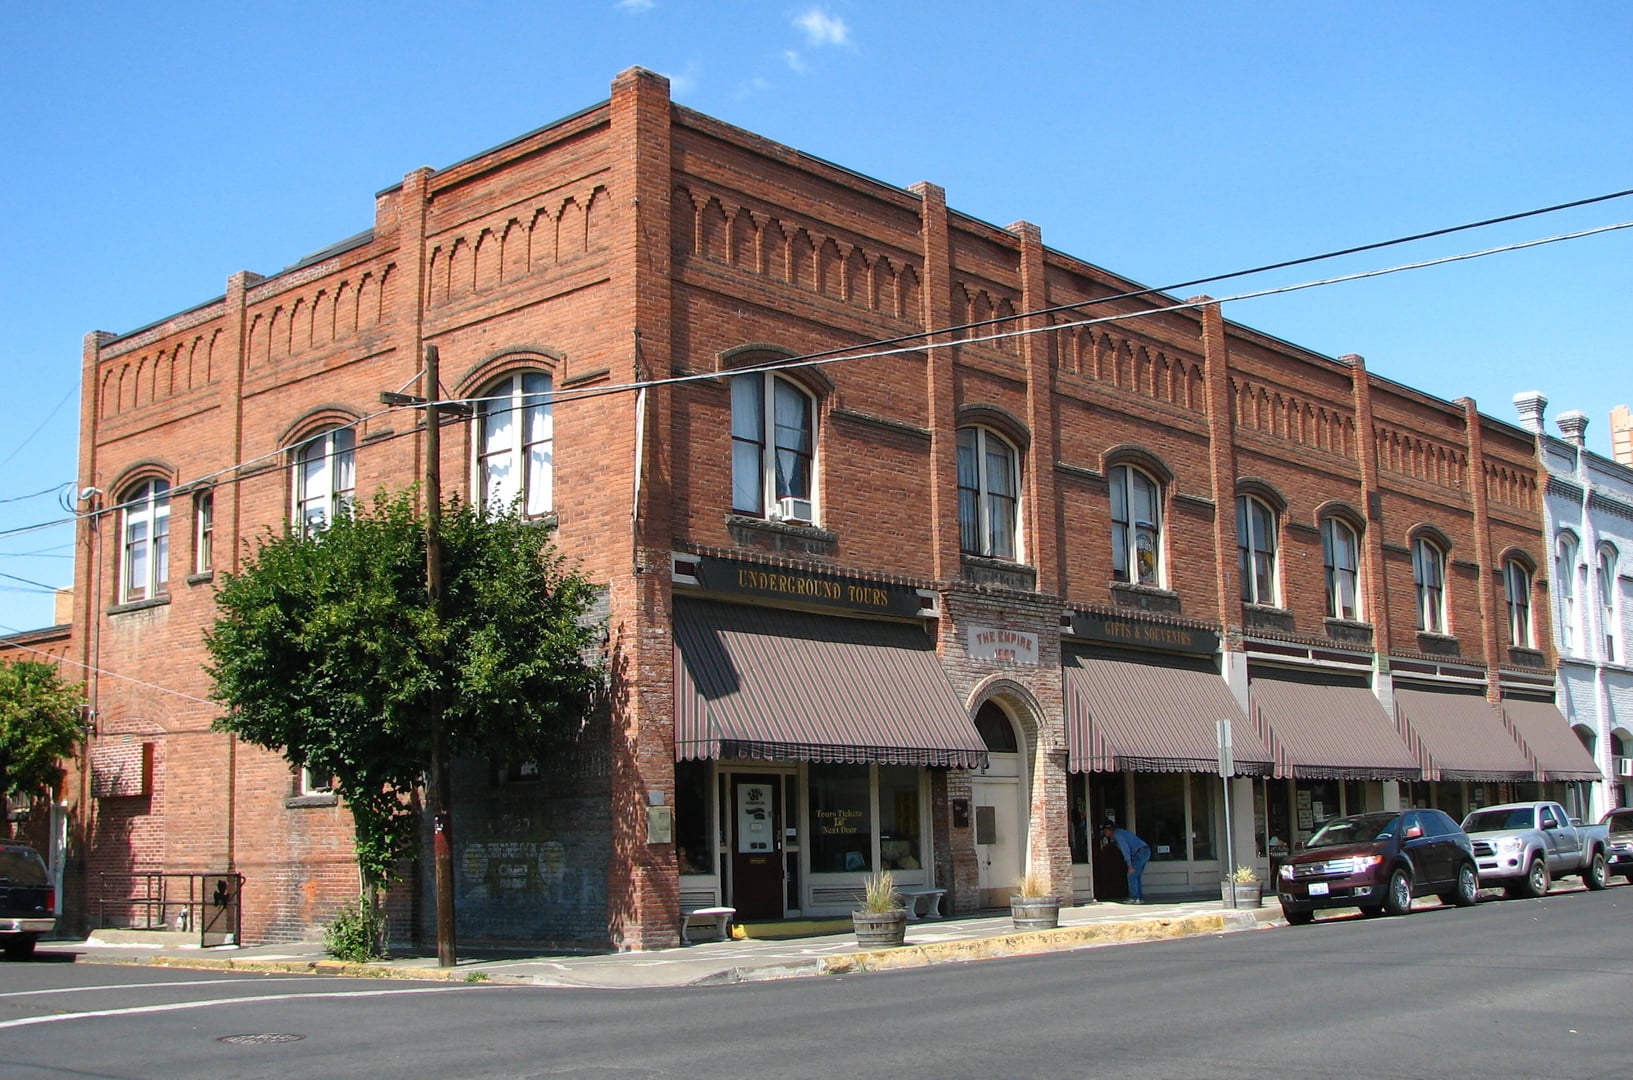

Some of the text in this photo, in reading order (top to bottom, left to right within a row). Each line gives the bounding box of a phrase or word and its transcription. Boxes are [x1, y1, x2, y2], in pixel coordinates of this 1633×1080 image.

[738, 569, 888, 607] UNDERGROUND TOURS
[1104, 620, 1131, 638] GIFTS
[976, 631, 1033, 651] THE EMPIRE
